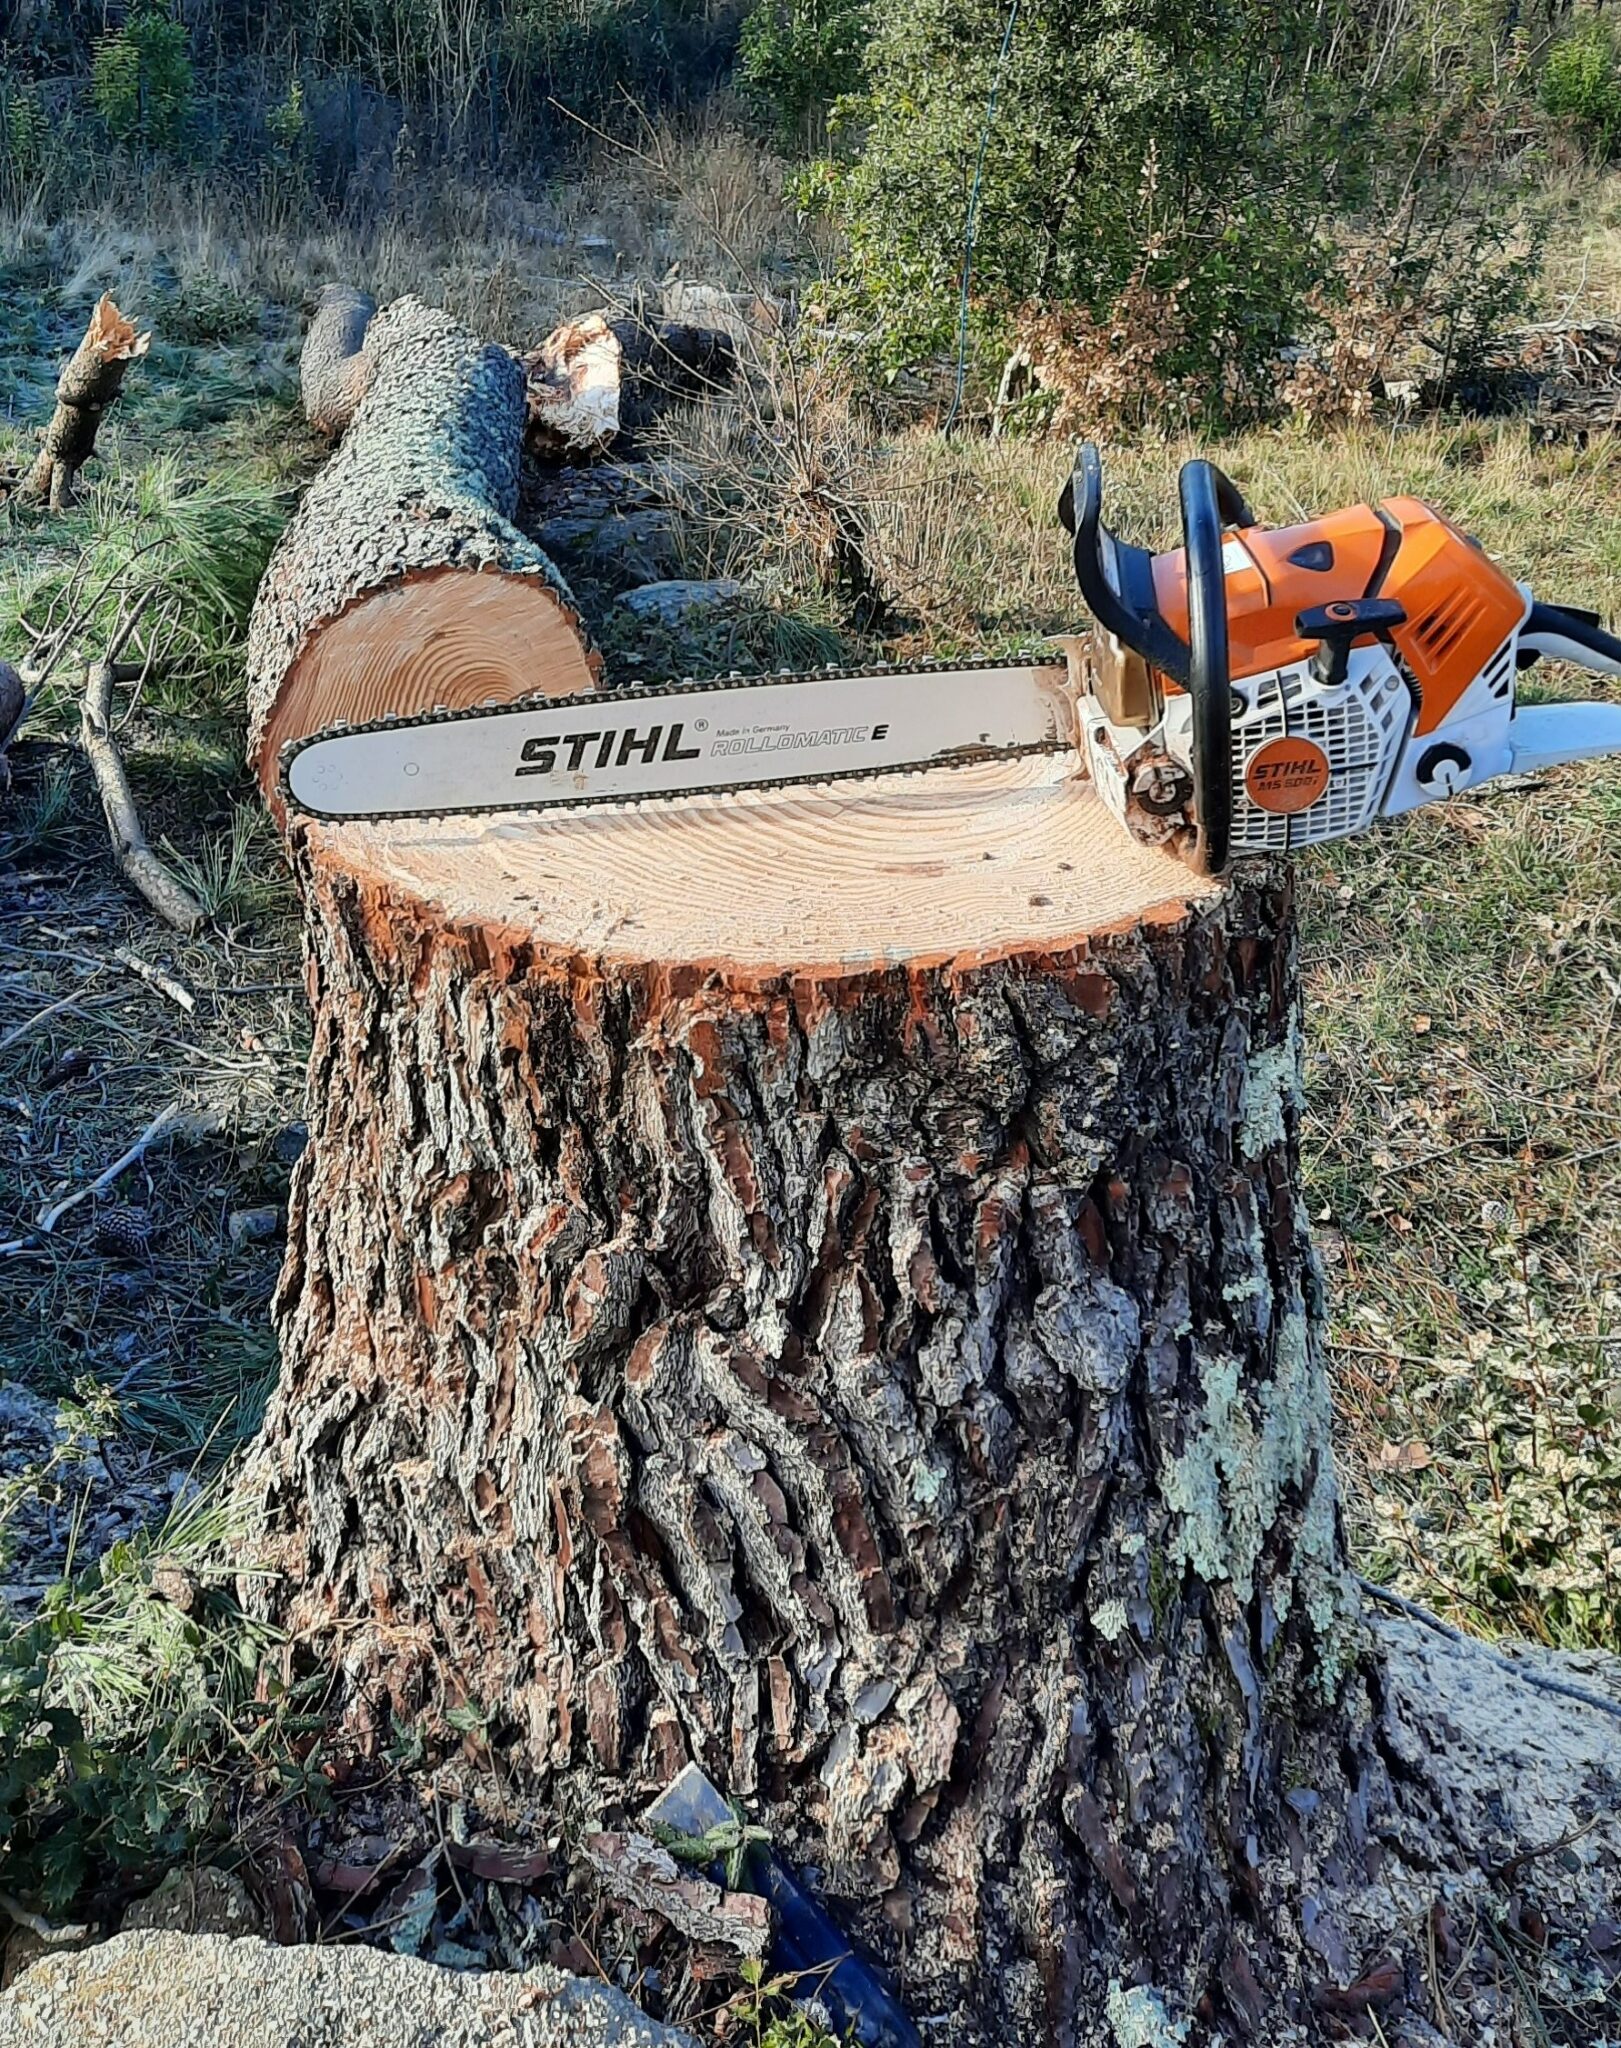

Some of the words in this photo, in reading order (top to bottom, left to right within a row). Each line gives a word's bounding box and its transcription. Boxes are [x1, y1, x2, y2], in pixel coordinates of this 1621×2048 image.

[710, 726, 869, 757] ROLLOMATIC
[871, 724, 890, 741] E
[716, 729, 740, 737] Made
[752, 724, 791, 734] Germany
[514, 723, 701, 777] STIHL
[1252, 759, 1322, 780] STIHL
[1258, 780, 1282, 791] MS
